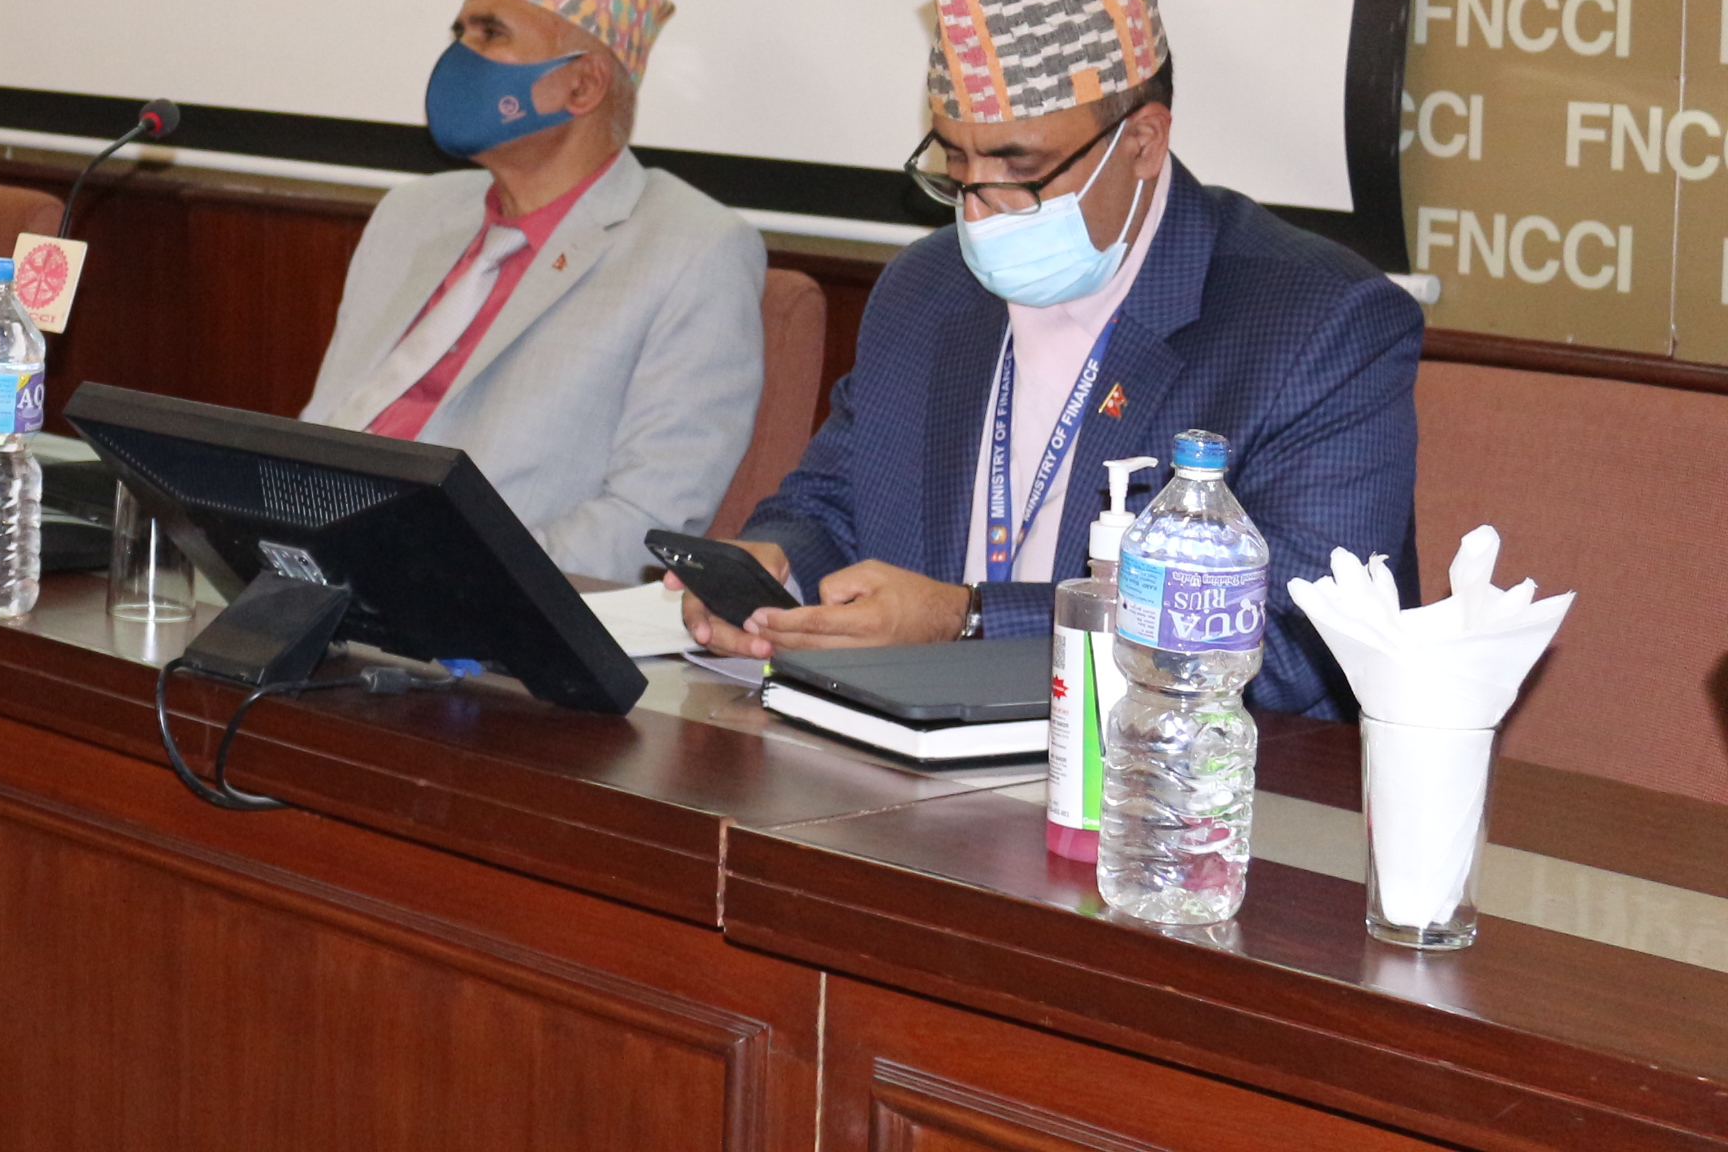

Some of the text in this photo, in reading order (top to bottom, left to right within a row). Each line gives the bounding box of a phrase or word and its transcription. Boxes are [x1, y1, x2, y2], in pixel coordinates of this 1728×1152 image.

[1564, 101, 1728, 181] FNC
[1416, 206, 1634, 294] FNCCI
[993, 419, 1006, 441] OF
[990, 442, 1006, 519] MINISTRY
[1023, 449, 1059, 523] MINISTRY
[1050, 426, 1069, 451] OF
[1172, 571, 1201, 588] Water
